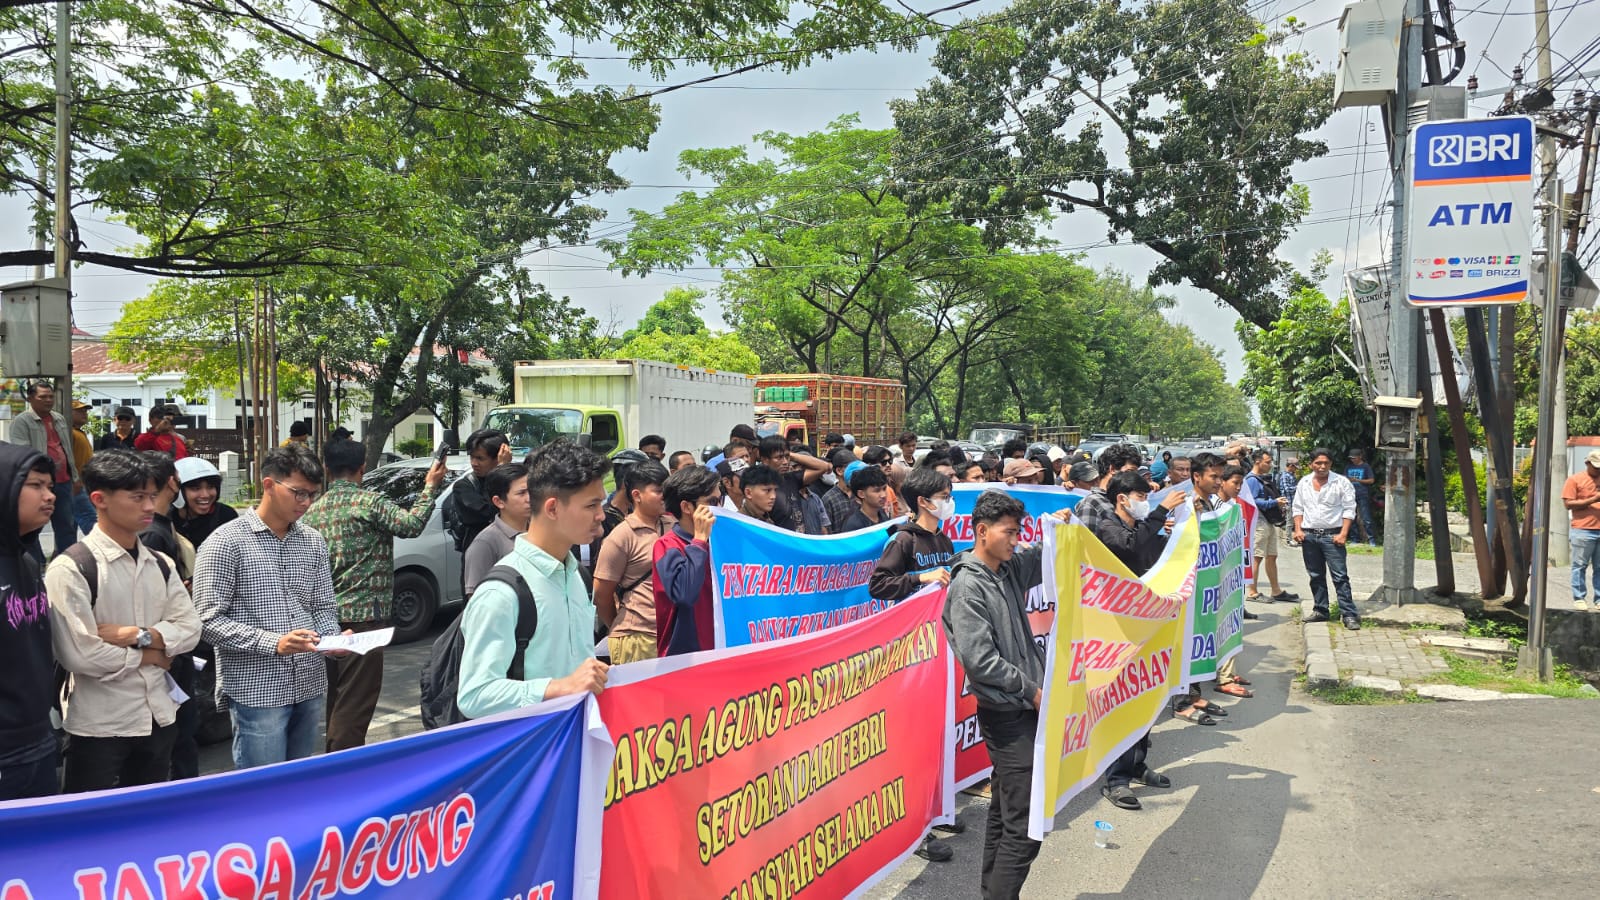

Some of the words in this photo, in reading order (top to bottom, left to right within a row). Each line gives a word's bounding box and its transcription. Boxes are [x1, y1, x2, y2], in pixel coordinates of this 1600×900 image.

[1465, 133, 1520, 163] BRI
[1428, 202, 1512, 227] ATM
[1463, 256, 1486, 265] VISA
[1486, 269, 1521, 277] BRIZZI
[721, 564, 790, 599] TENTARA
[790, 563, 852, 595] MENJAGA
[696, 684, 783, 766] AGUNG
[784, 662, 839, 729] PASTI
[696, 754, 797, 865] SETORAN
[796, 731, 842, 801] DARI
[840, 710, 888, 779] FEBRI
[813, 791, 881, 877] SELAMA
[880, 777, 906, 831] INI
[297, 793, 477, 900] AGUNG
